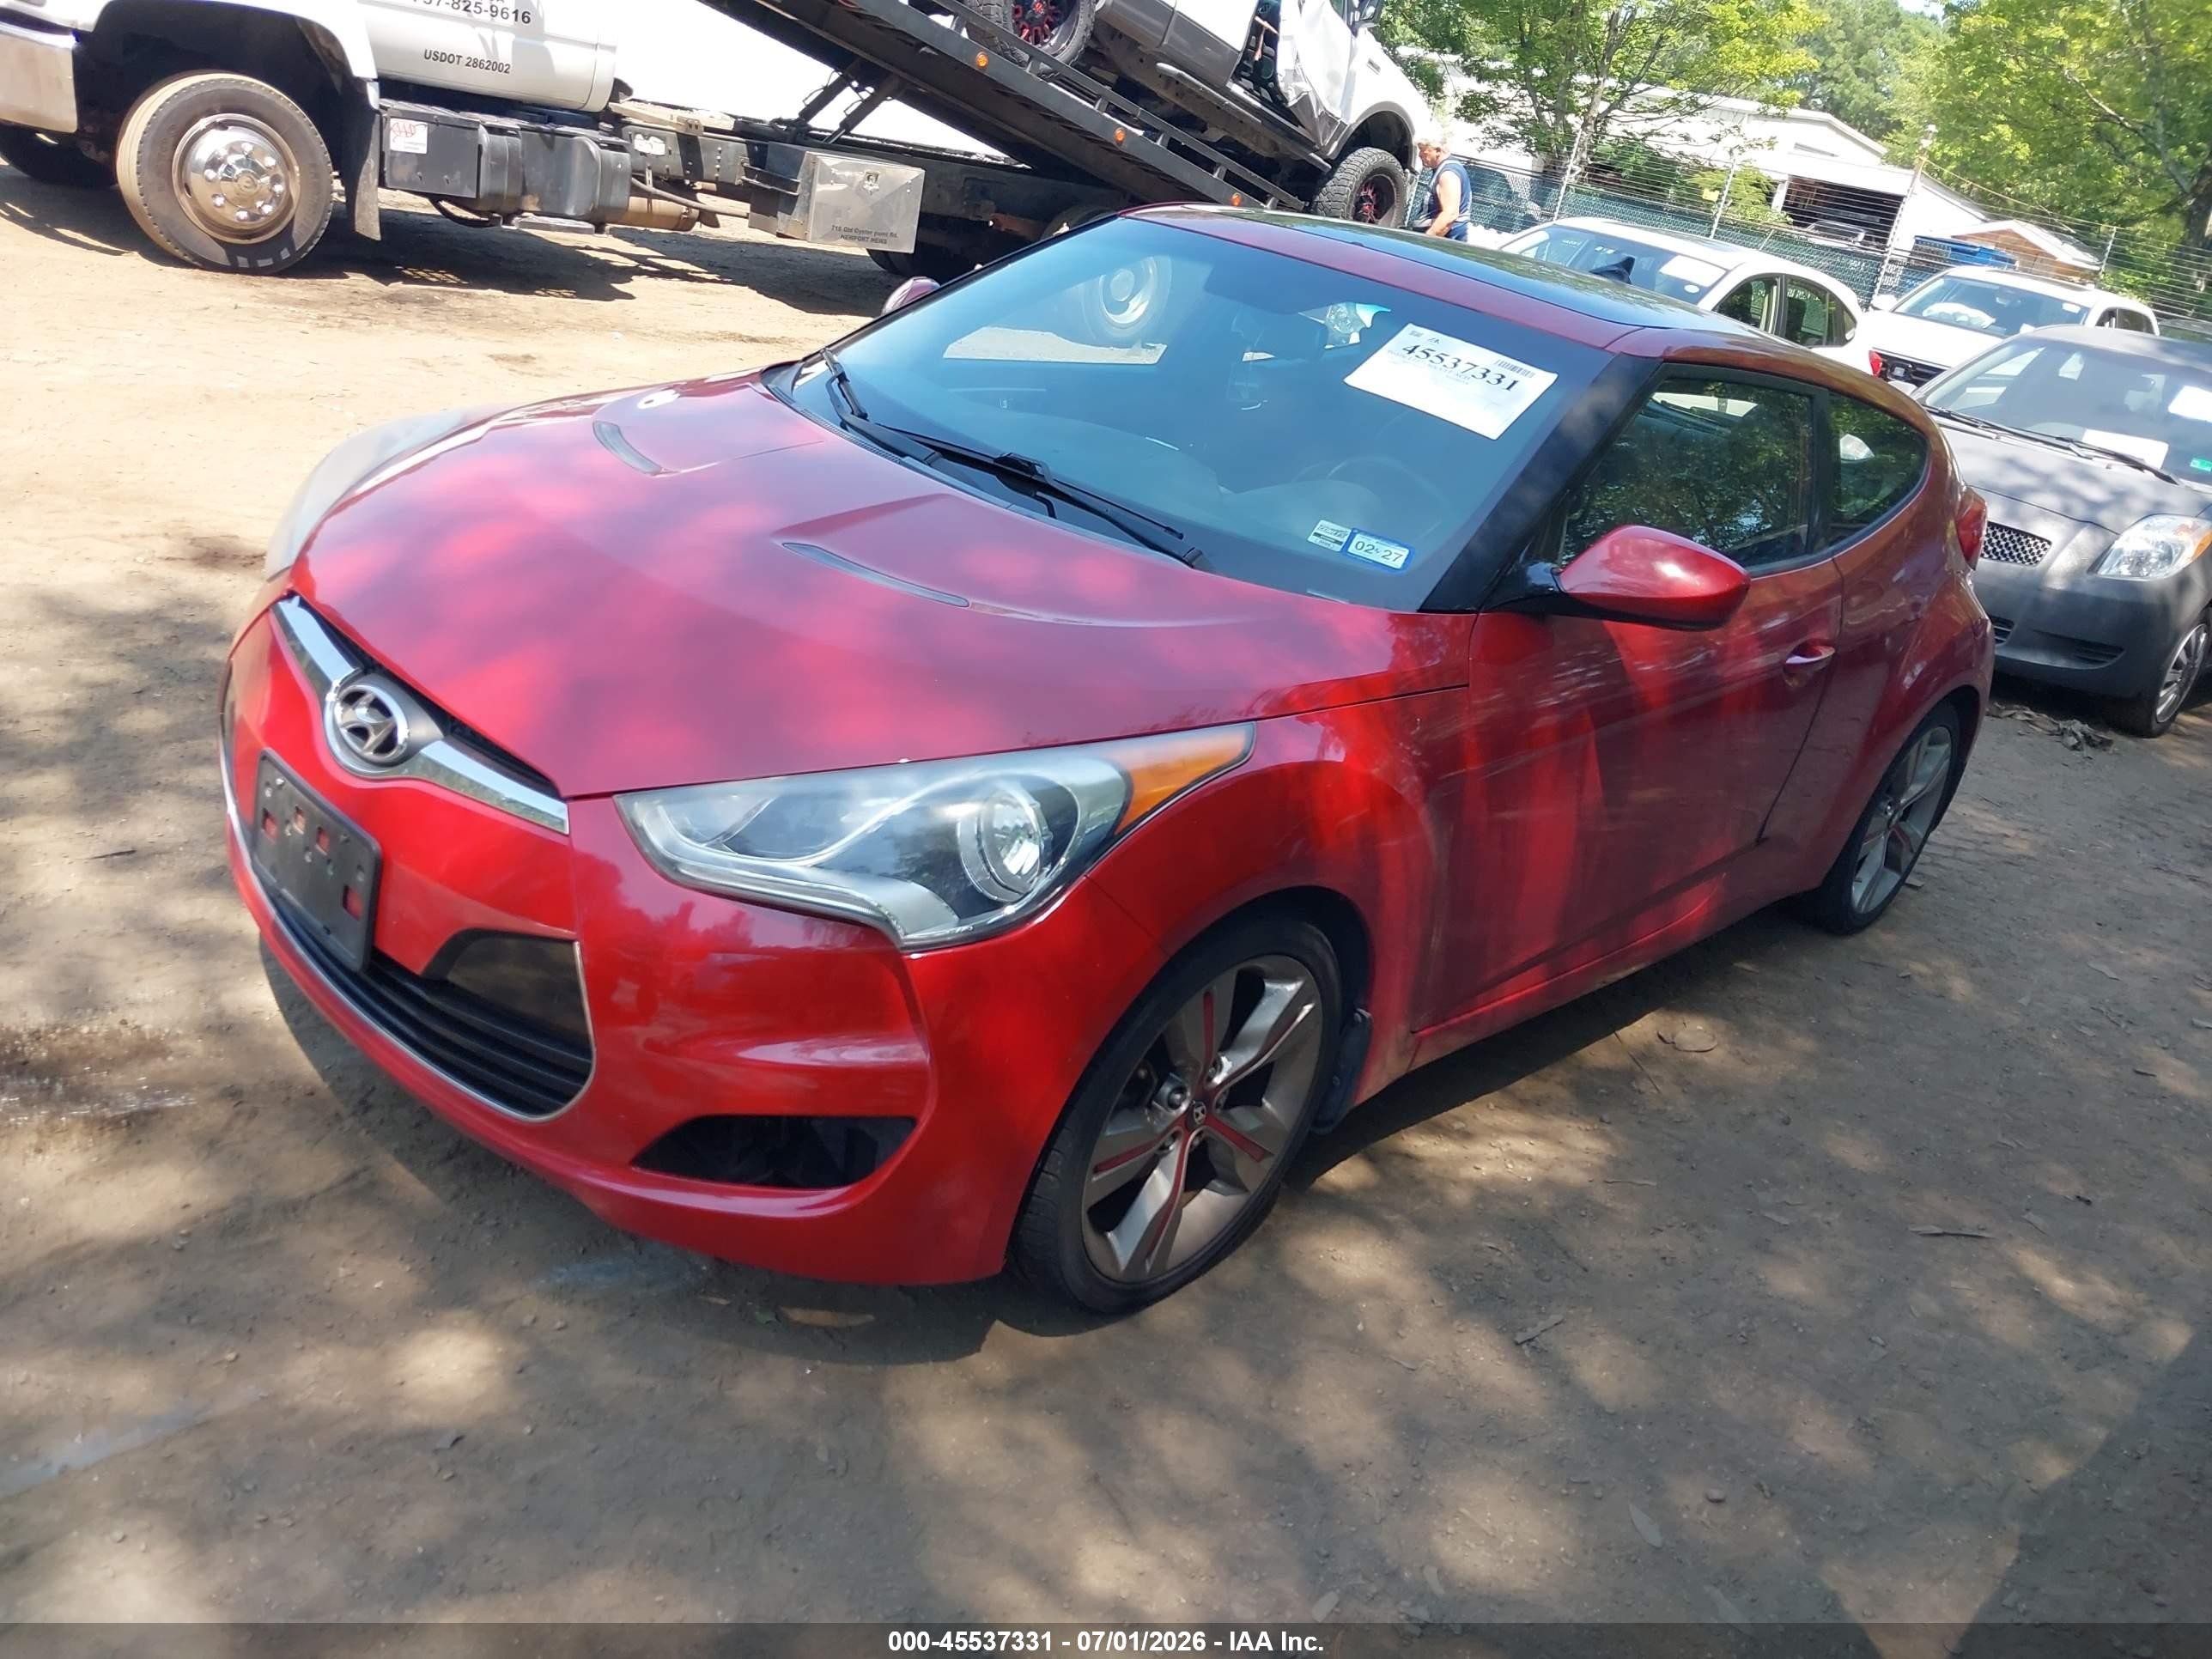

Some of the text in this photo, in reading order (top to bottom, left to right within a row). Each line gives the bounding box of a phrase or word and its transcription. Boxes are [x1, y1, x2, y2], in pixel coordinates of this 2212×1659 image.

[413, 0, 532, 24] -825-9616
[424, 49, 511, 74] USDOT 2862002
[1401, 344, 1519, 392] 45537331
